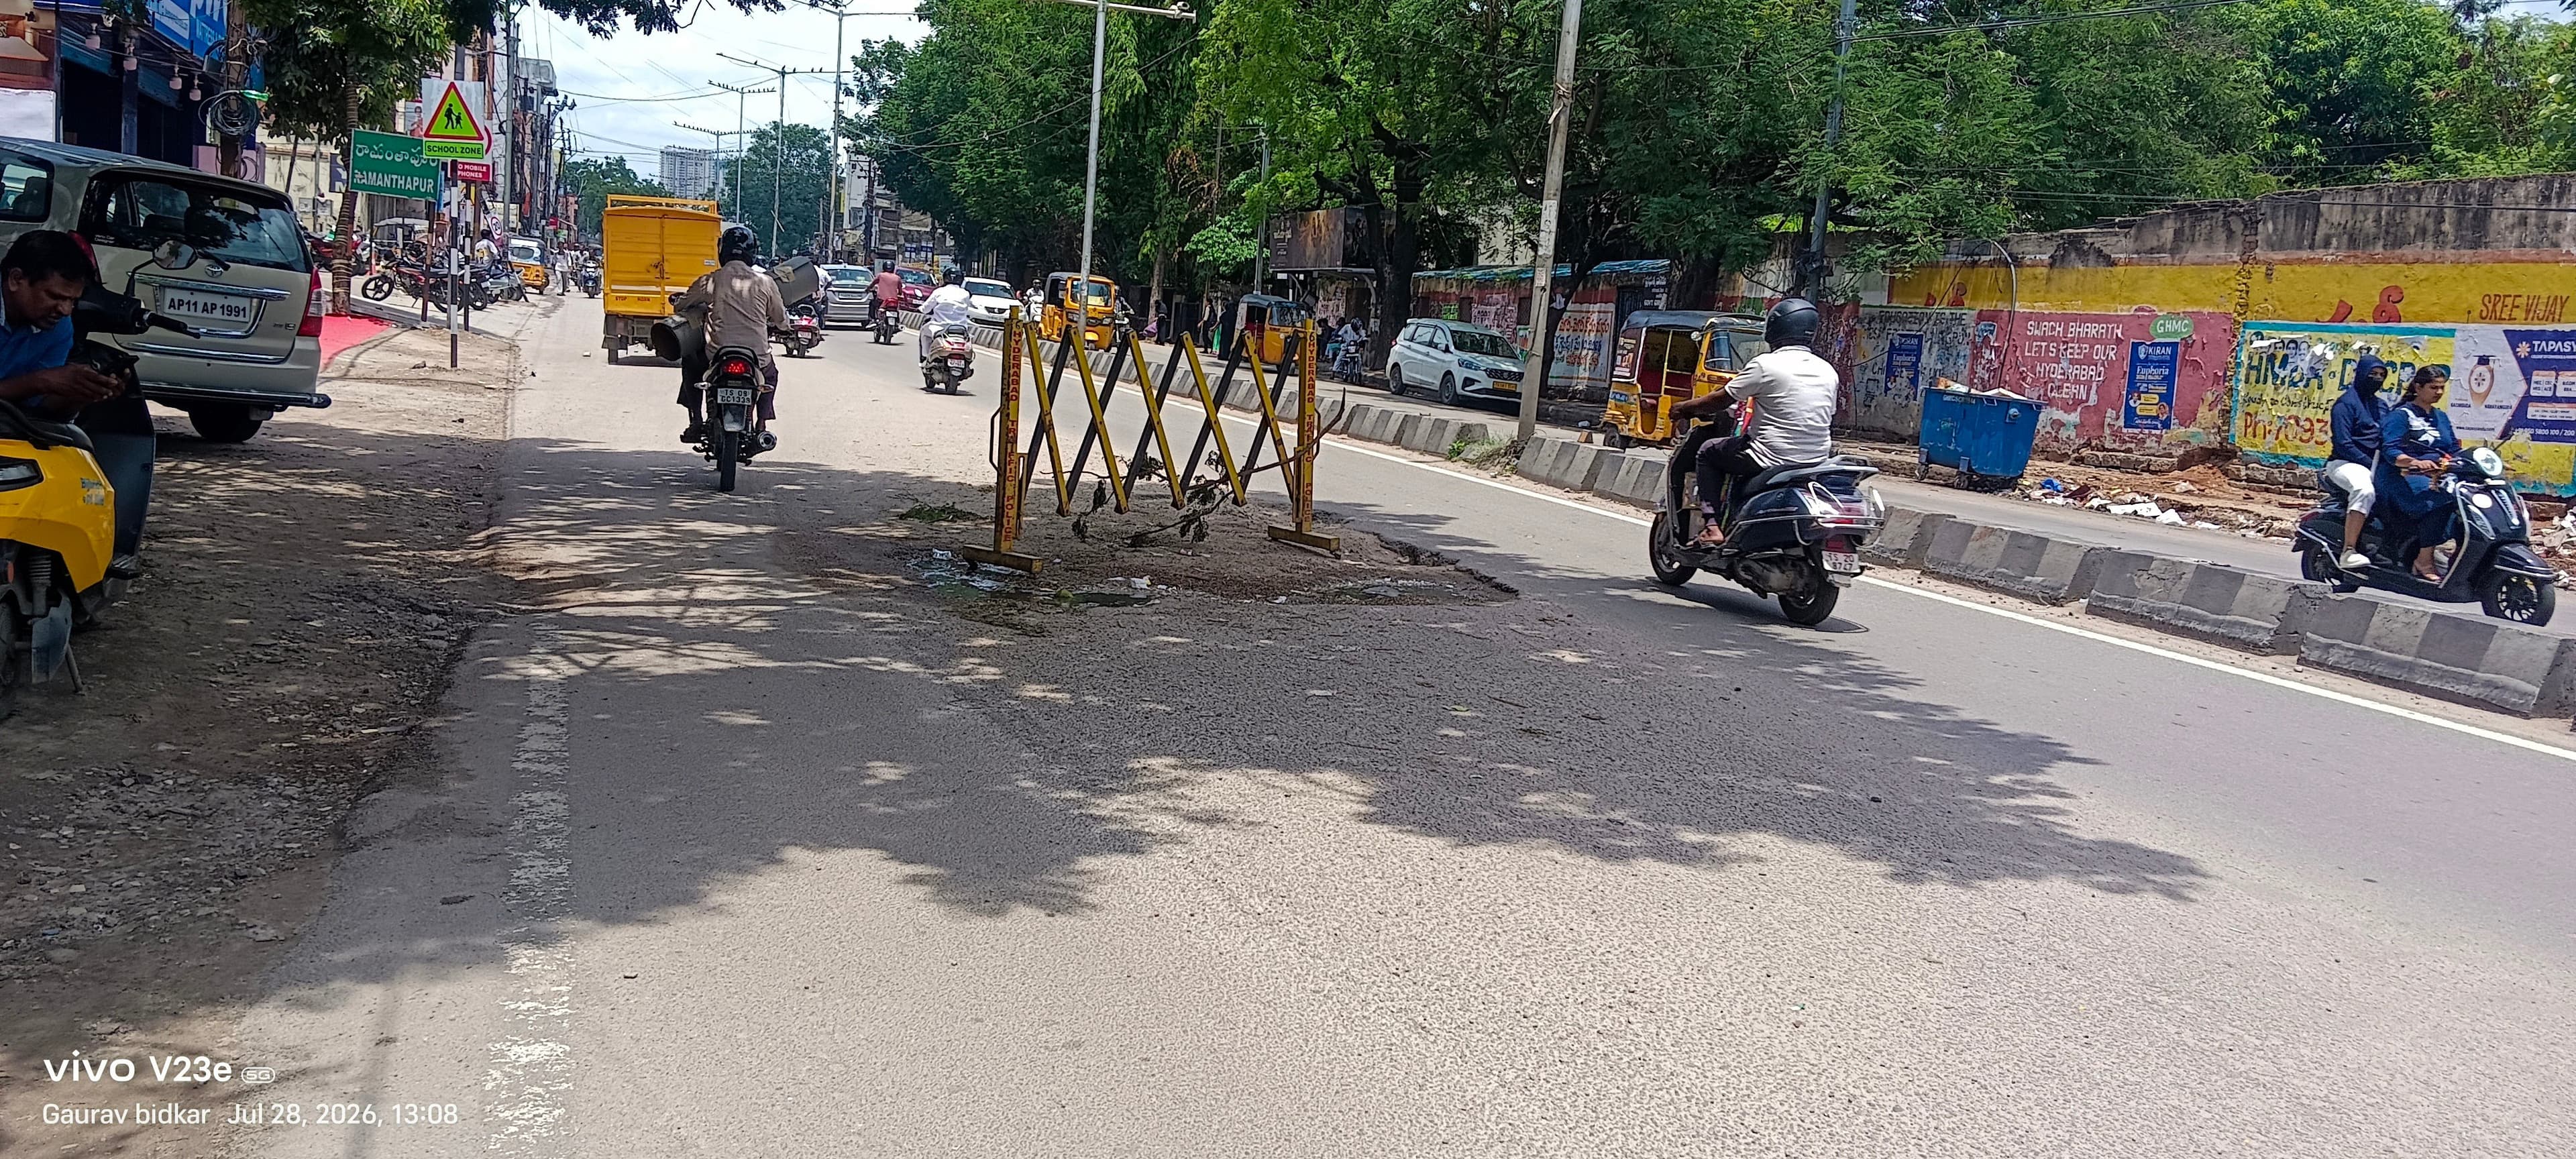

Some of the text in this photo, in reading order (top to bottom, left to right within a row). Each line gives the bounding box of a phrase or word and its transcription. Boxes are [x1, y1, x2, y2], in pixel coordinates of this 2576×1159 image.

[427, 145, 481, 155] SCHOOL ZONE
[354, 170, 435, 193] RAMANTHAPUR
[494, 221, 500, 231] 20
[168, 298, 247, 318] AP11 AP 1991
[2479, 294, 2570, 323] SREE VIJAY
[2027, 321, 2123, 339] SWACH BHARATH
[2157, 320, 2189, 333] GHMC
[2059, 343, 2089, 359] KEEP
[2092, 345, 2117, 360] OUR
[2149, 346, 2171, 355] KIRAN
[1010, 331, 1022, 401] HYDERABAD
[1307, 342, 1316, 403] HYDERABAD
[2137, 366, 2169, 376] Euphoria
[2338, 358, 2416, 396] DCP
[2047, 382, 2088, 400] CLEAN
[1303, 483, 1312, 522] POLICE
[1003, 496, 1014, 542] POLICE
[1843, 554, 1855, 562] 20
